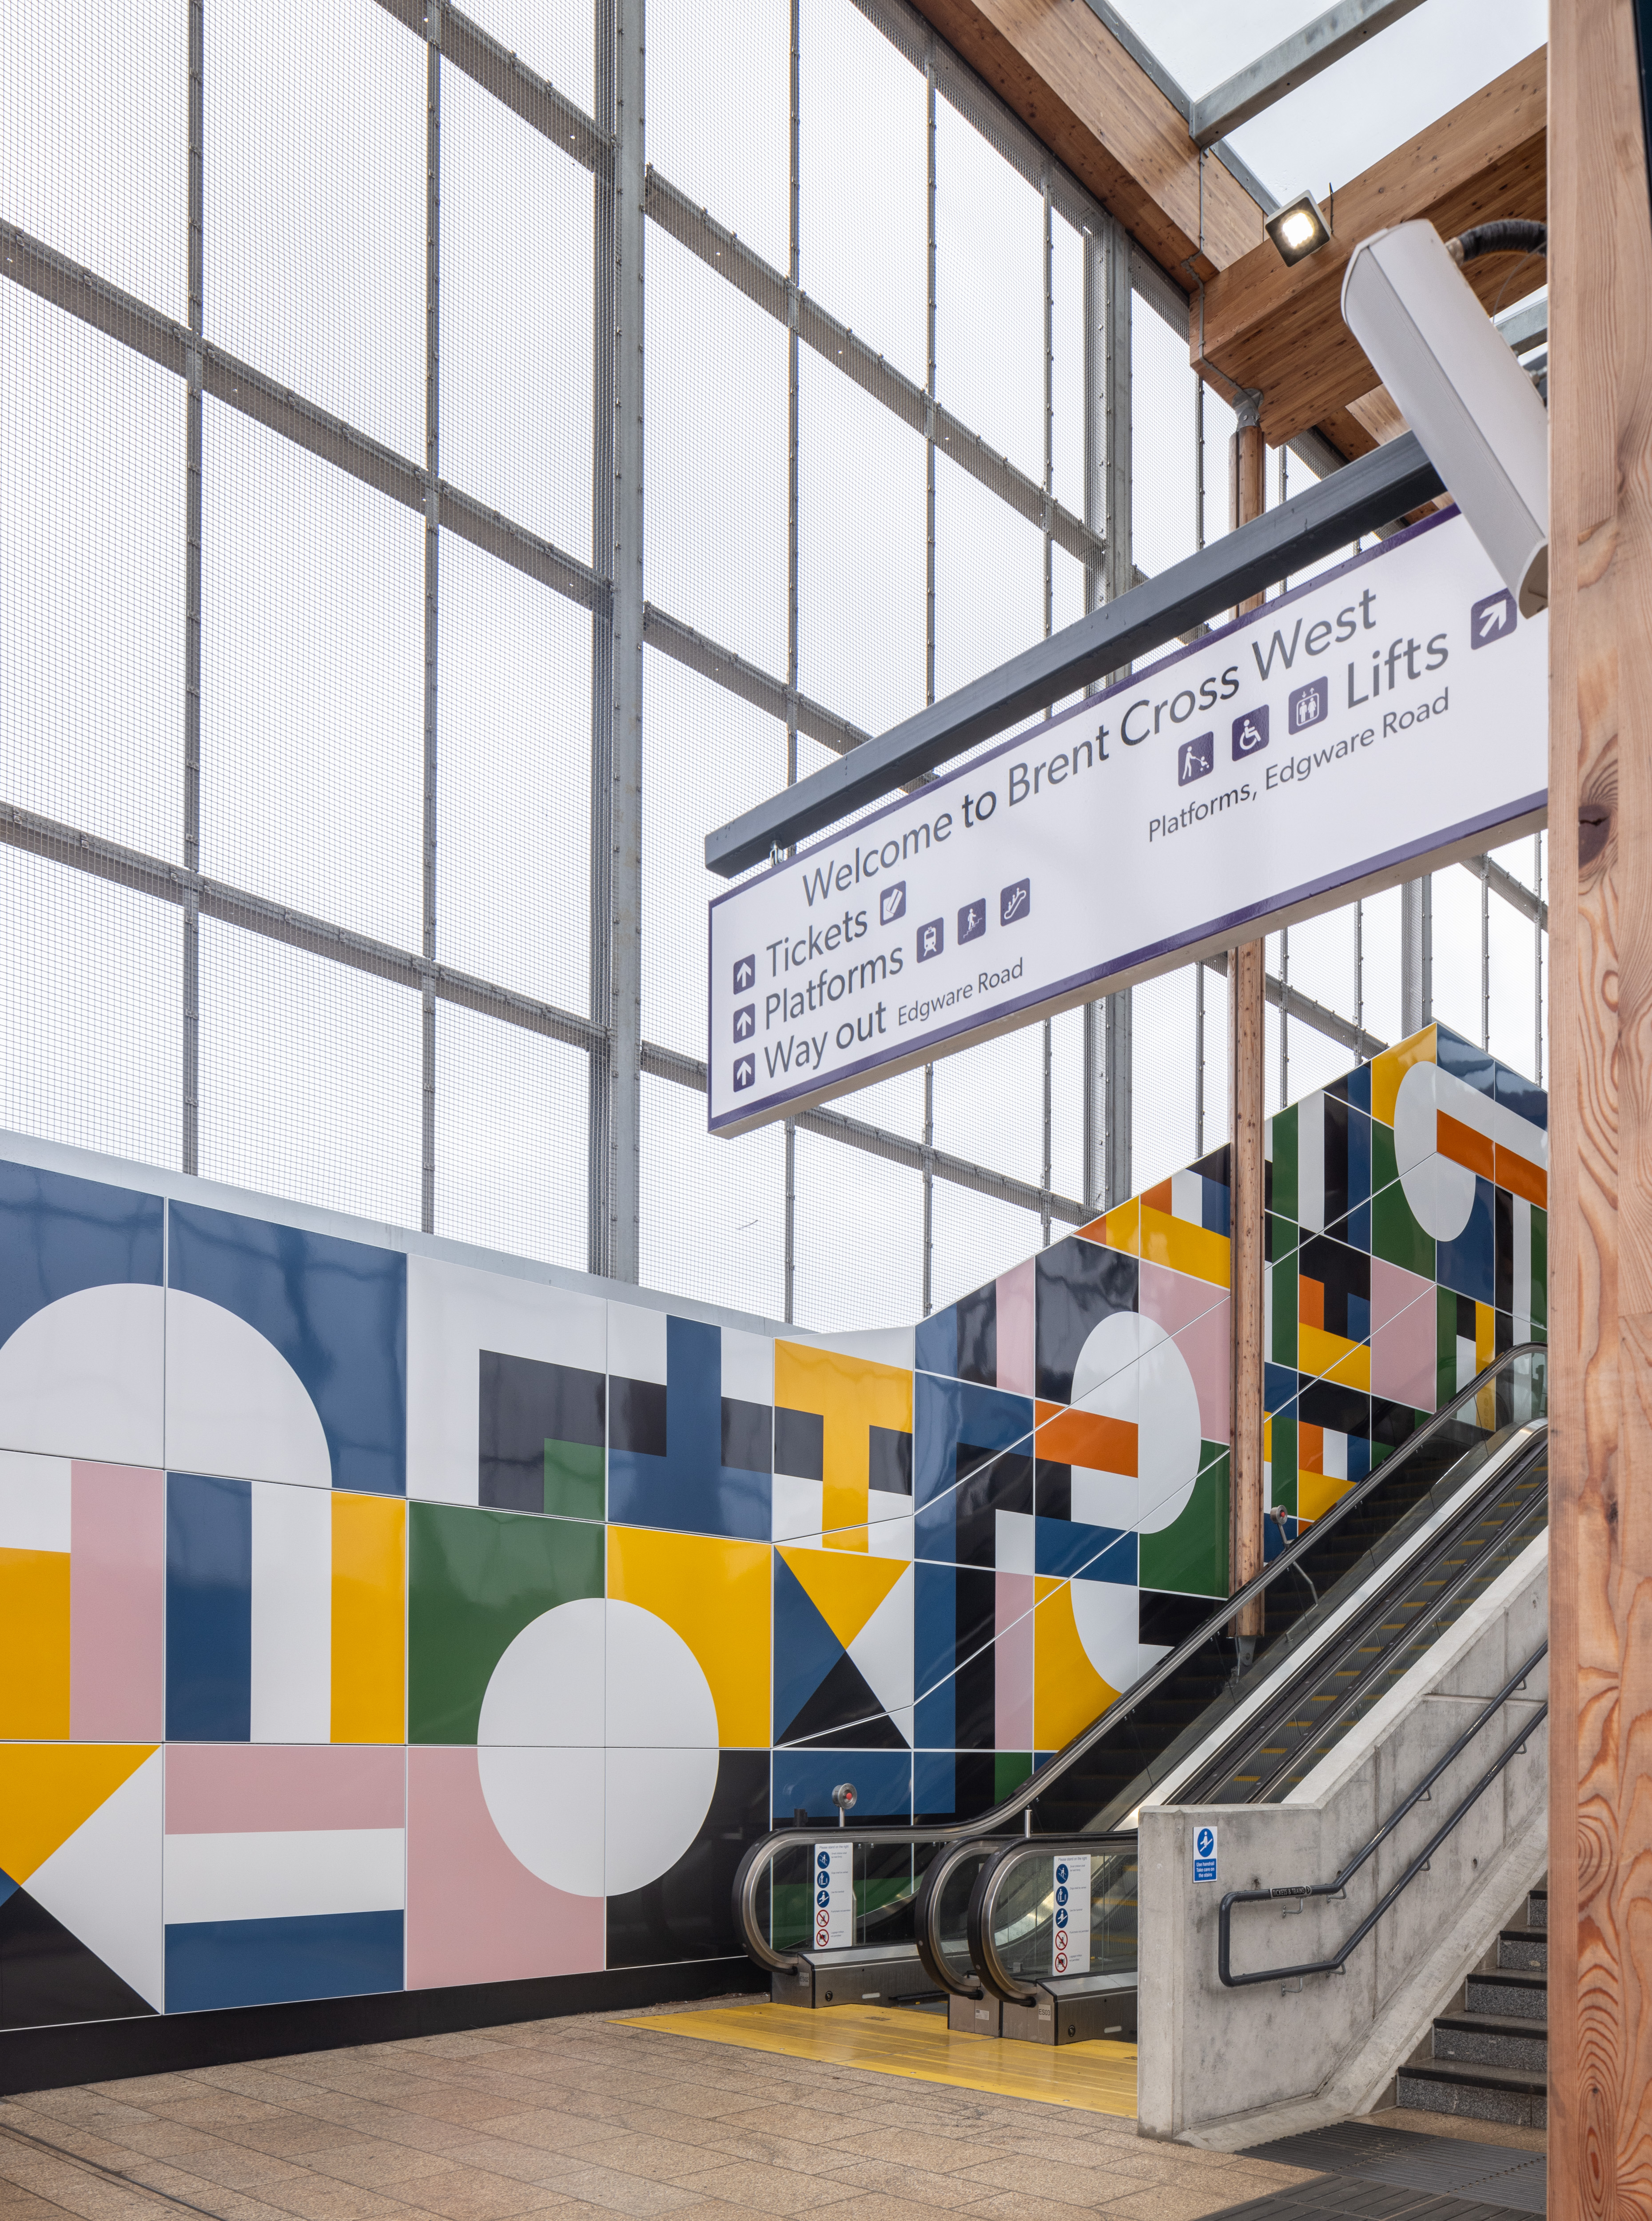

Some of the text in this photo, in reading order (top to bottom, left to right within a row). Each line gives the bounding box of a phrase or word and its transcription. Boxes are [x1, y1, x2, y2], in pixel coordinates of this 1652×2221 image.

[1348, 633, 1448, 708] Lifts
[803, 589, 1376, 907] Welcome to Brent Cross West
[1150, 687, 1448, 842] Platforms, Edgware Road
[766, 947, 903, 1030] Platforms
[767, 911, 867, 977] Tickets
[764, 957, 1022, 1078] Way out Edgware Road
